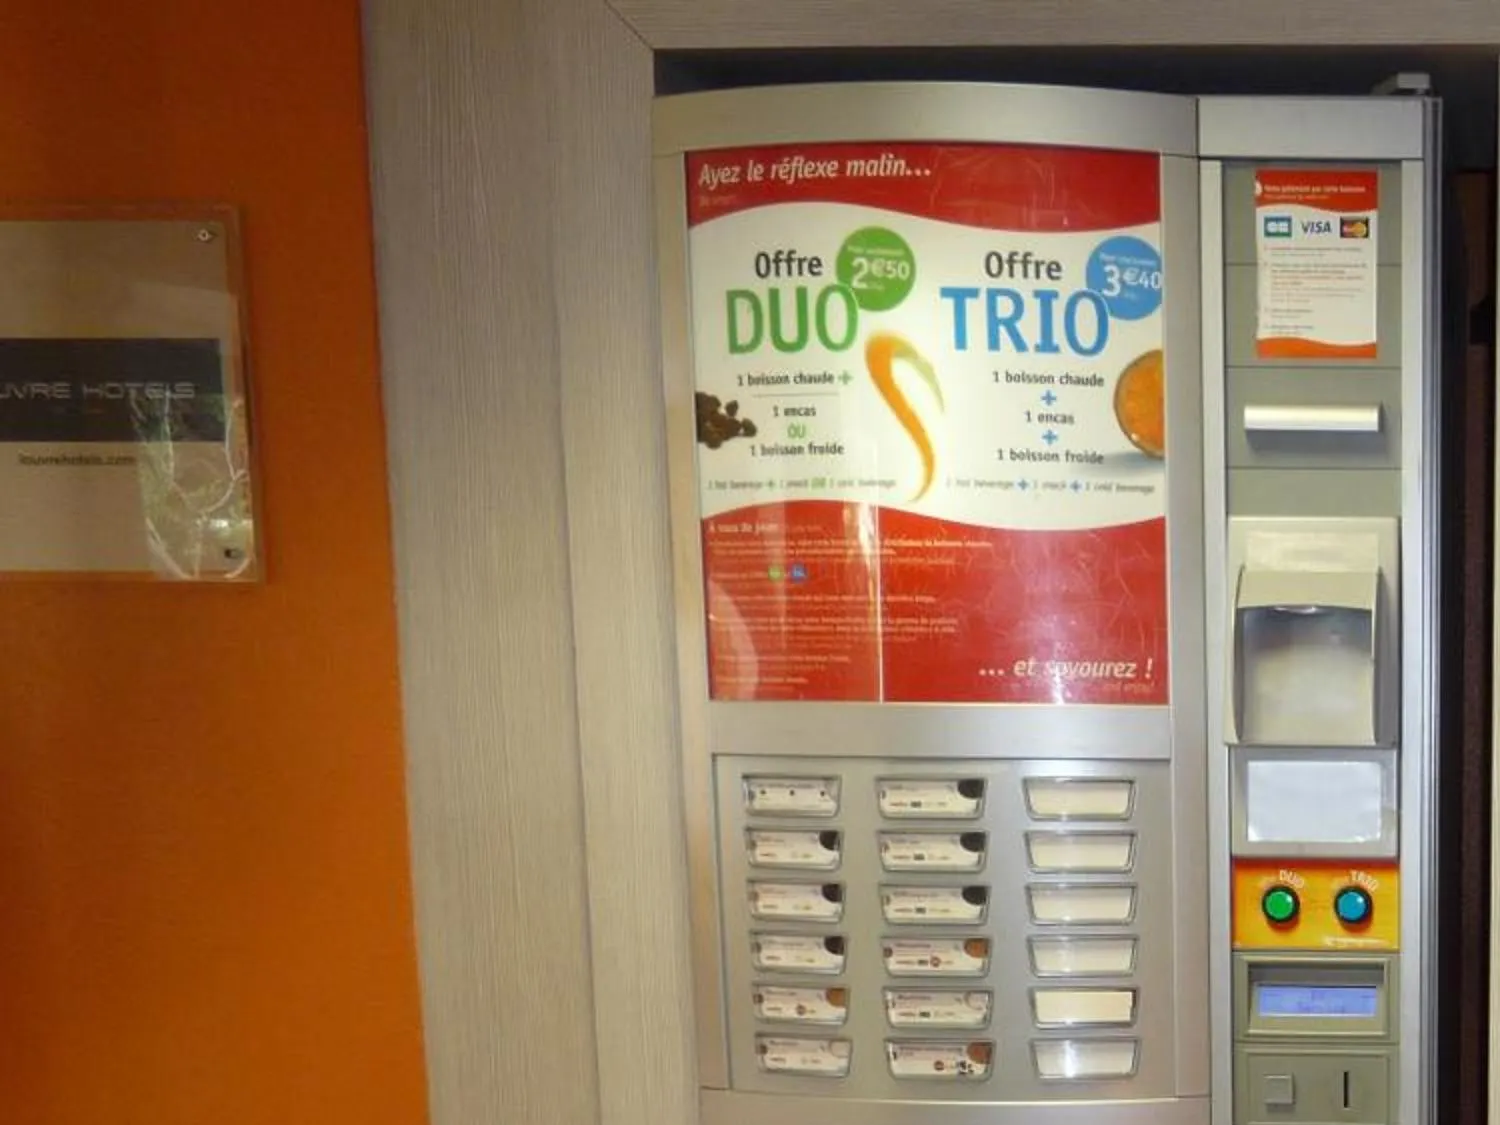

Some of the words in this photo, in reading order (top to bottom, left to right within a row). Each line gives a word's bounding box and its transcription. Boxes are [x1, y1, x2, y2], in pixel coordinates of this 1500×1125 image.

[698, 162, 741, 186] Ayez
[747, 159, 764, 182] le
[770, 156, 838, 184] réflexe
[1301, 221, 1332, 235] VISA
[754, 250, 823, 279] Offre
[984, 250, 1062, 282] Offre
[726, 284, 859, 355] DUO
[940, 285, 1110, 357] TRIO
[748, 374, 790, 387] boisson
[793, 372, 835, 385] chaude
[1005, 371, 1055, 384] boisson
[1059, 373, 1105, 387] chaude
[82, 382, 196, 399] HOTELS
[784, 406, 816, 417] encas
[1037, 411, 1075, 425] encas
[760, 444, 804, 456] boisson
[808, 442, 845, 456] froide
[1009, 449, 1060, 462] boisson
[1064, 450, 1105, 464] froide
[1013, 658, 1039, 678] et
[1279, 869, 1304, 889] DUO
[1350, 869, 1378, 892] TRIO
